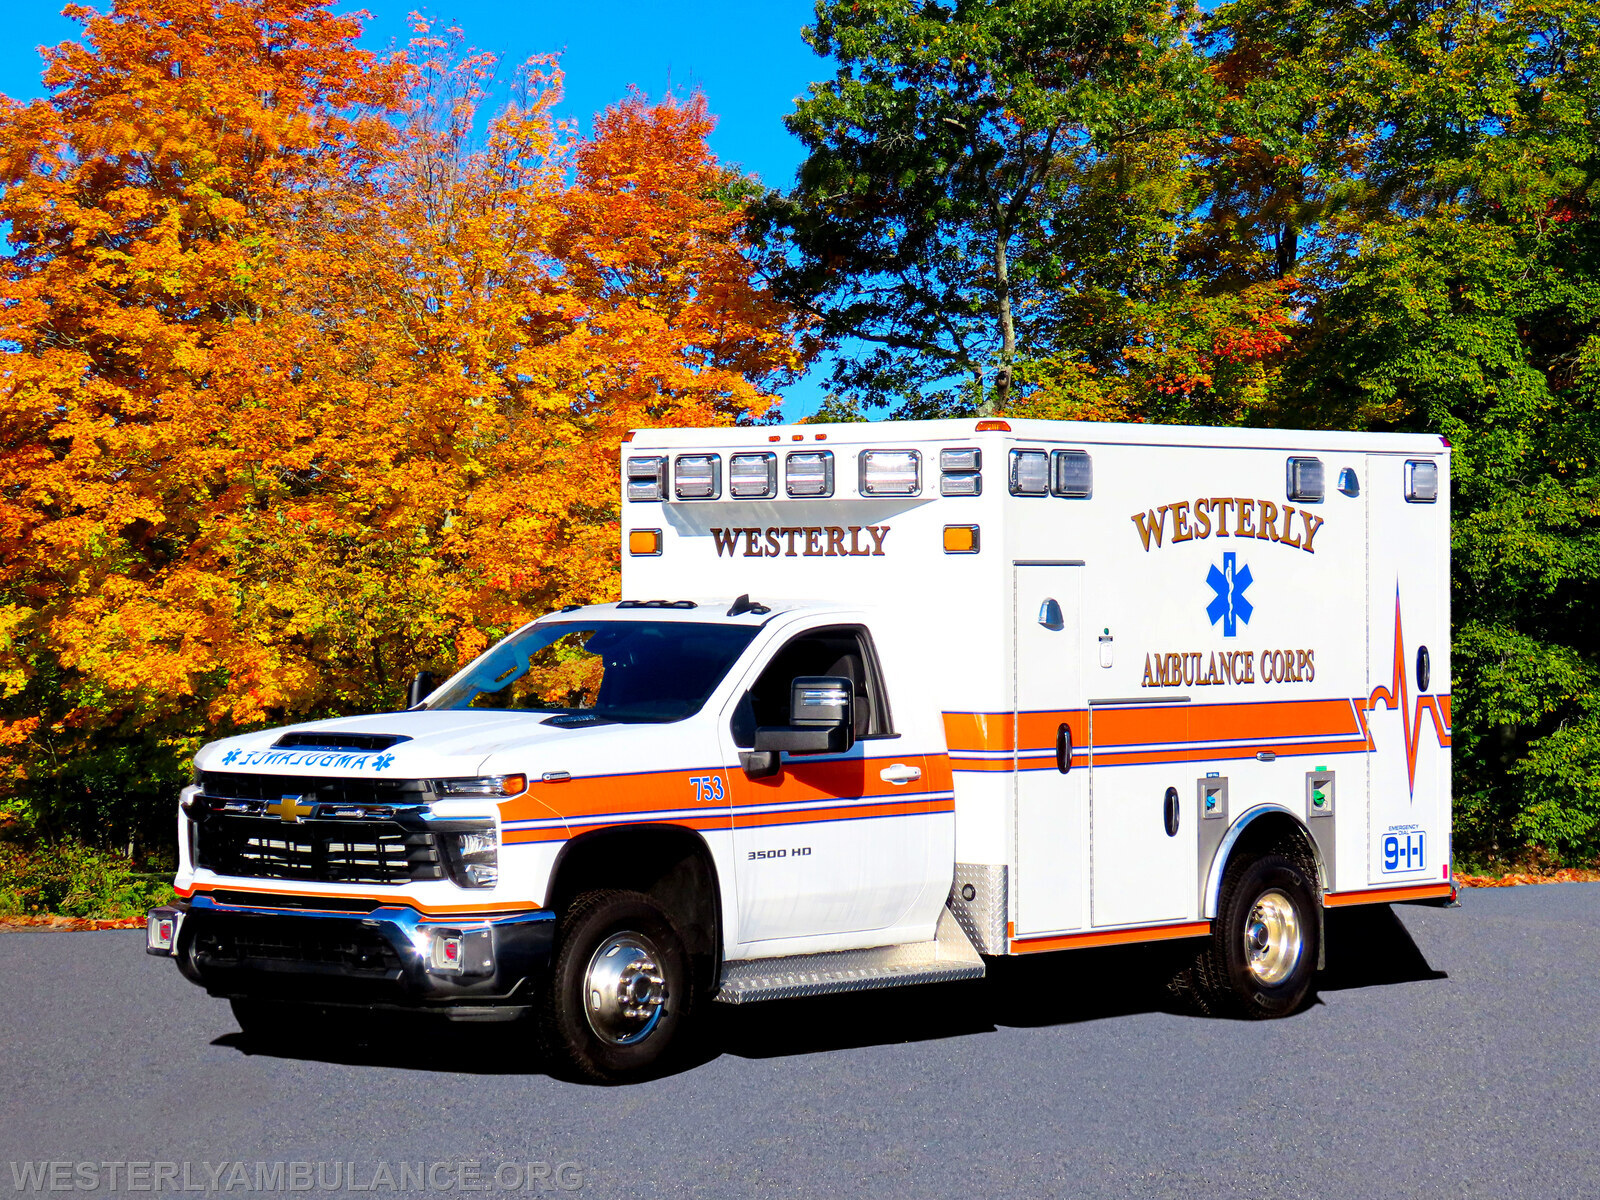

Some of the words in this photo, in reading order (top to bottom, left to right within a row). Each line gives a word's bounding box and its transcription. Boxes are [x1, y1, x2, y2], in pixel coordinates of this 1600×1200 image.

[1131, 497, 1324, 554] WESTERLY
[710, 526, 890, 557] WESTERLY
[1141, 650, 1255, 688] AMBULANCE
[1260, 649, 1315, 684] CORPS
[689, 775, 725, 801] 753
[747, 849, 787, 861] 3500
[791, 847, 812, 857] HD
